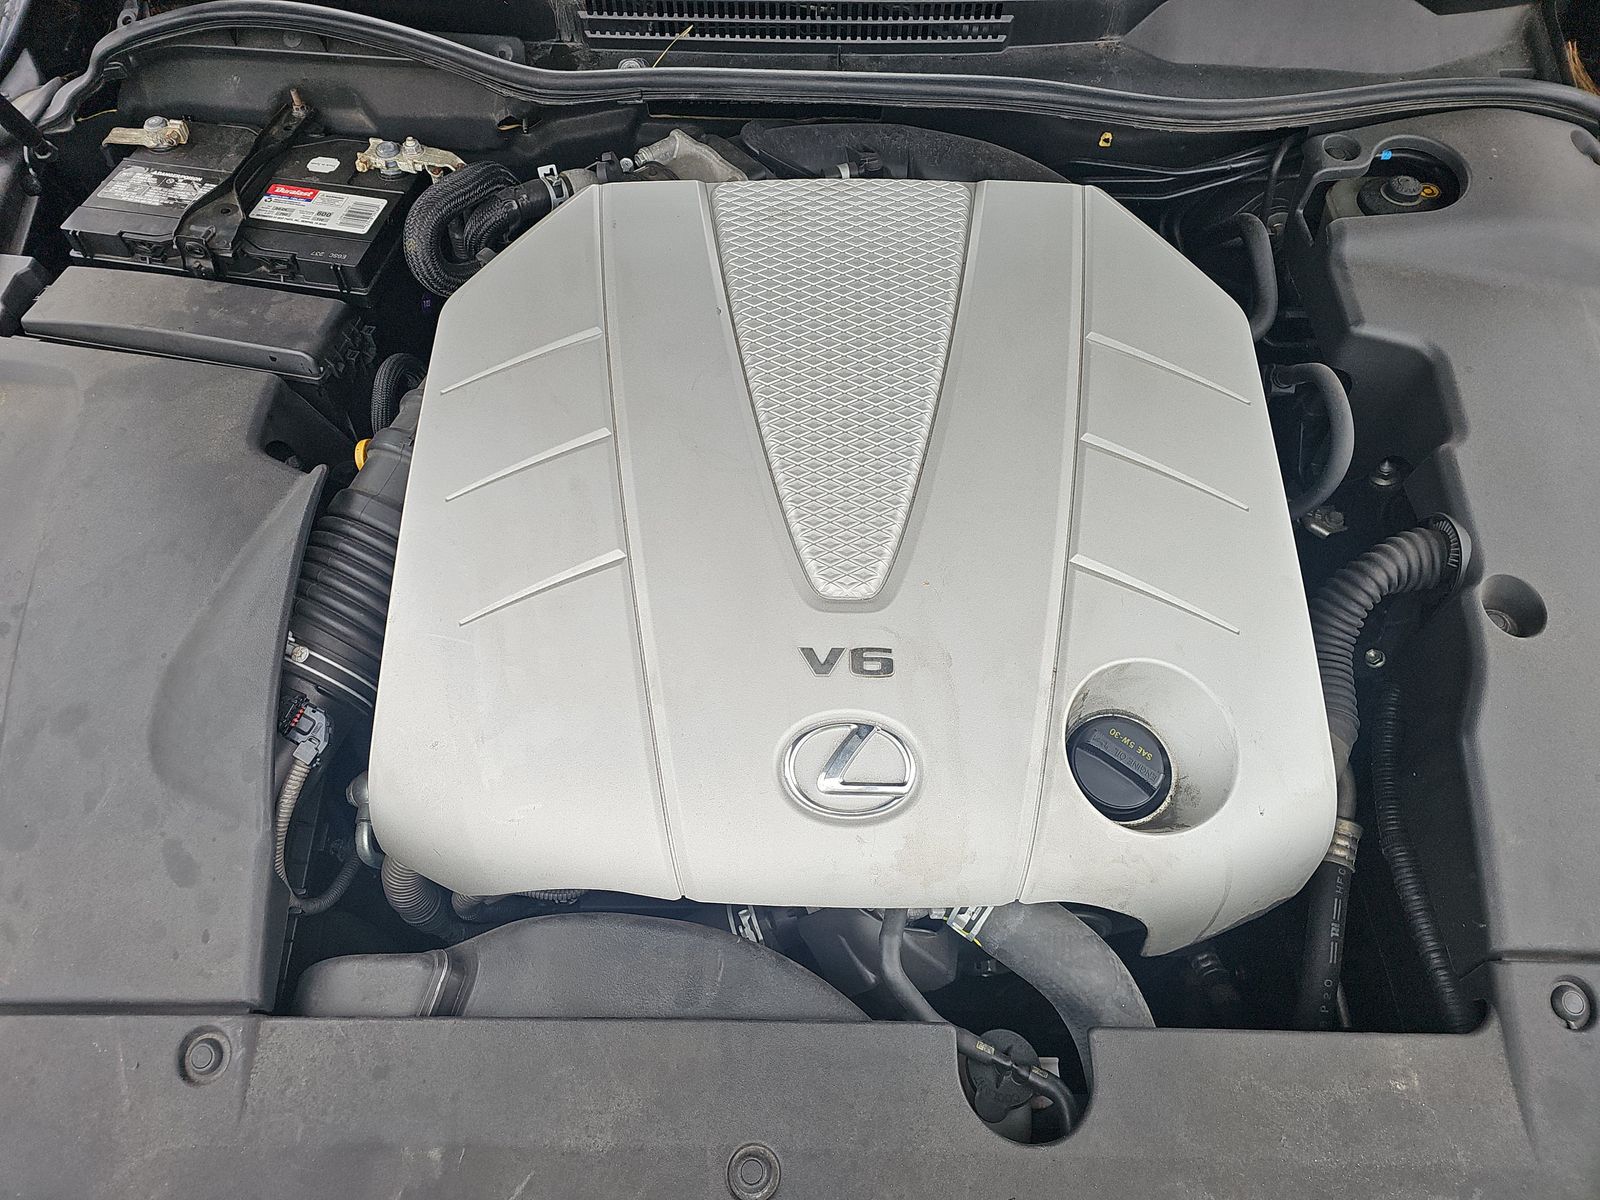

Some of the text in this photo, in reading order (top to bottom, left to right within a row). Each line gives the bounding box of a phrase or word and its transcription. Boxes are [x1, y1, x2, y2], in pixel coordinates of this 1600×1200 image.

[274, 186, 314, 197] Duralast
[316, 210, 332, 218] 600
[799, 647, 894, 676] V6
[1109, 728, 1153, 761] SAE 5W-30
[1114, 748, 1158, 782] ENGINE OIL
